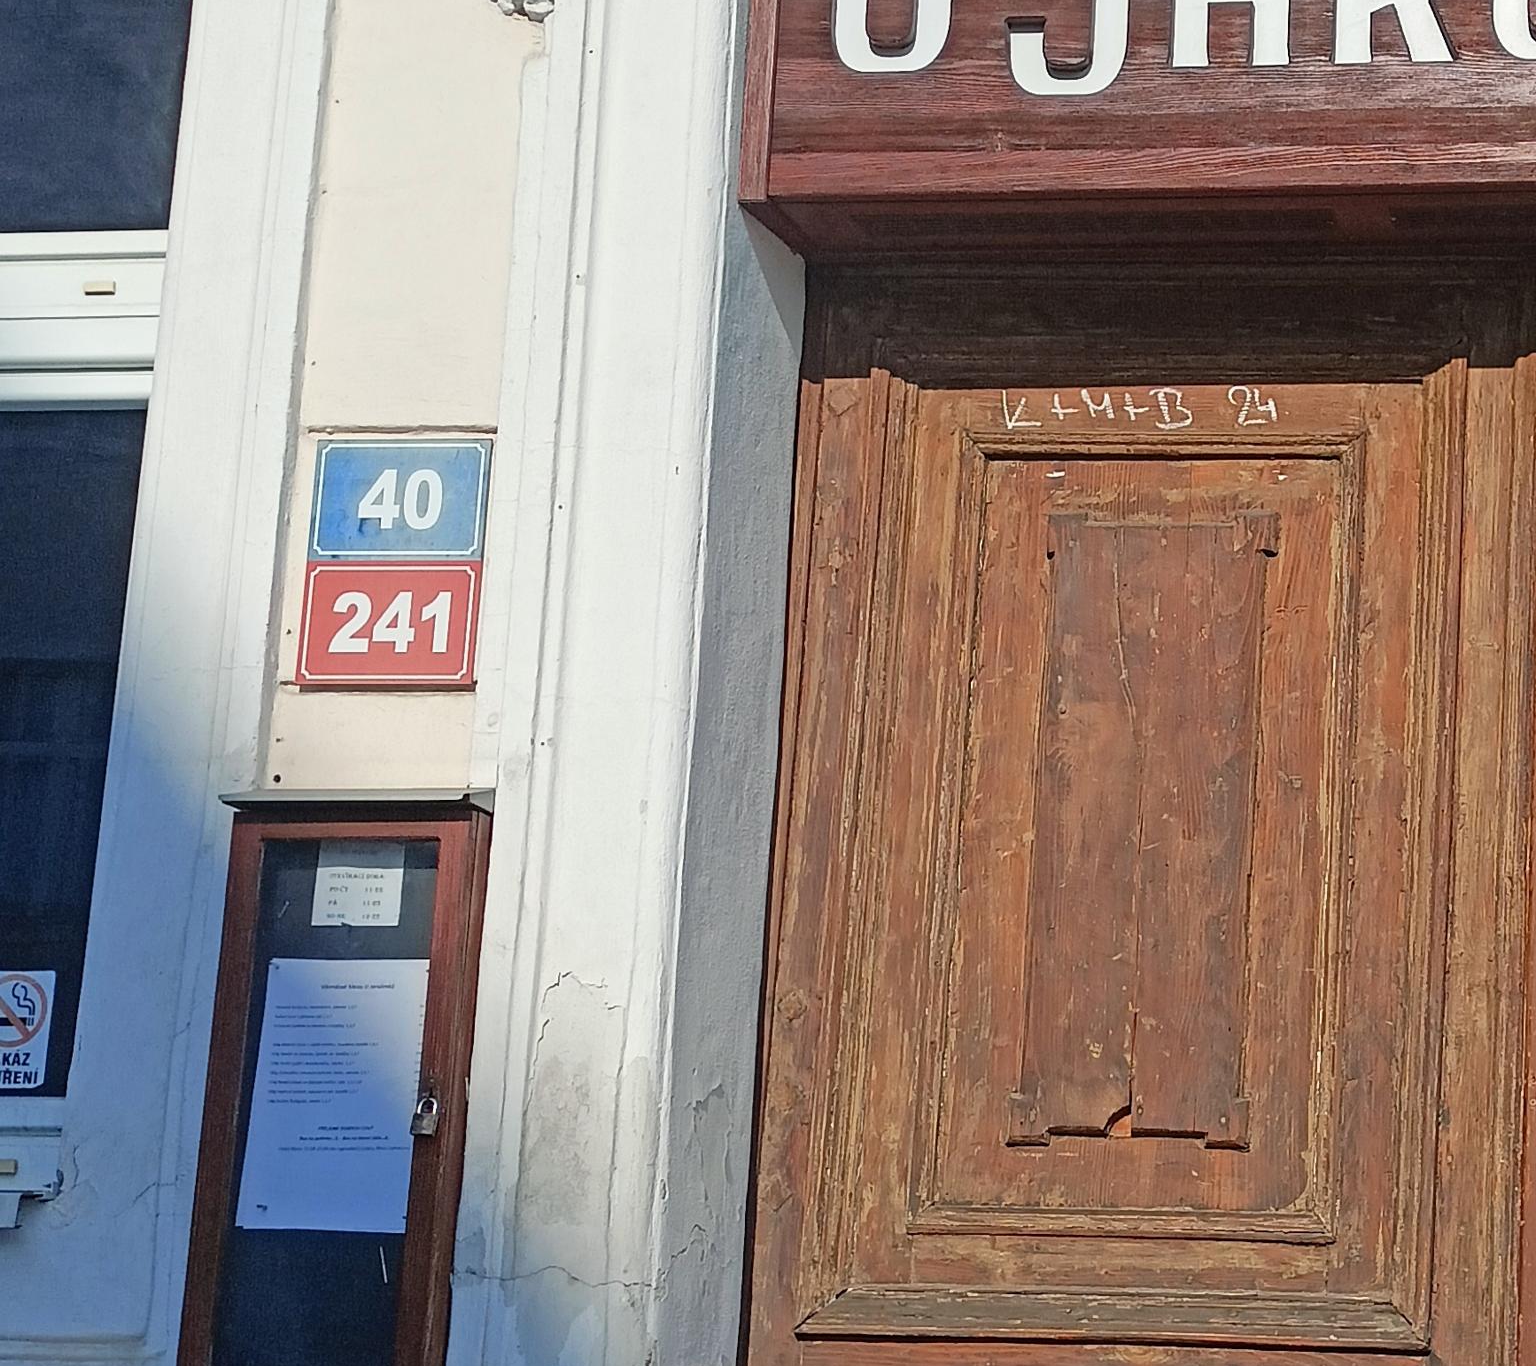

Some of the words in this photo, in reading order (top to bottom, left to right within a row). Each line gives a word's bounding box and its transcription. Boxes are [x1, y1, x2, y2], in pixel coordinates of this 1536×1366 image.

[1228, 385, 1277, 426] 24
[357, 469, 443, 531] 40
[327, 590, 453, 653] 241
[0, 1067, 39, 1085] ŘENÍ
